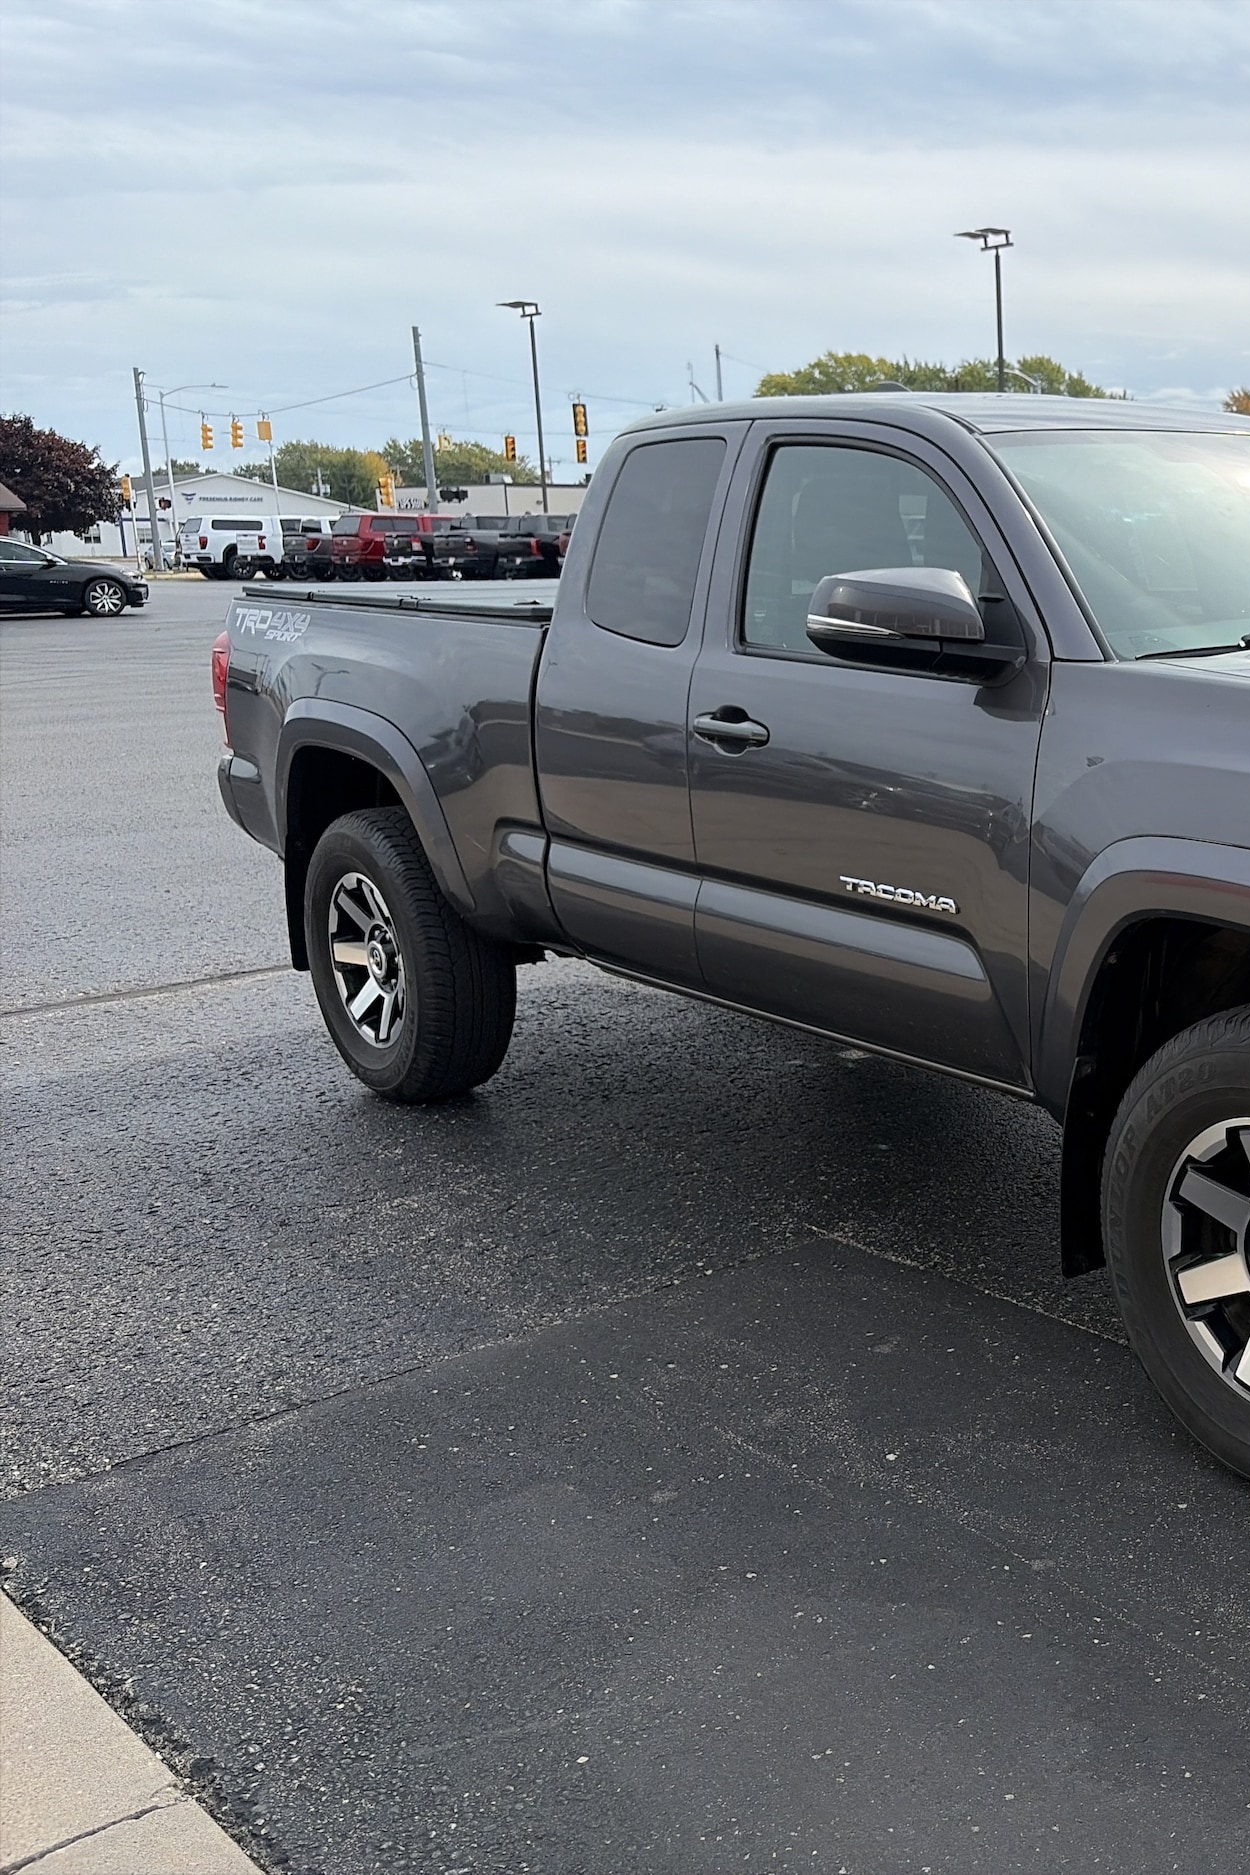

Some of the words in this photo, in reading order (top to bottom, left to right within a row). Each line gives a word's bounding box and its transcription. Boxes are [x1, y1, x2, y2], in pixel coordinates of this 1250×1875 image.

[235, 607, 273, 635] TRD
[264, 629, 303, 642] SPORT
[839, 875, 957, 914] TACOMA
